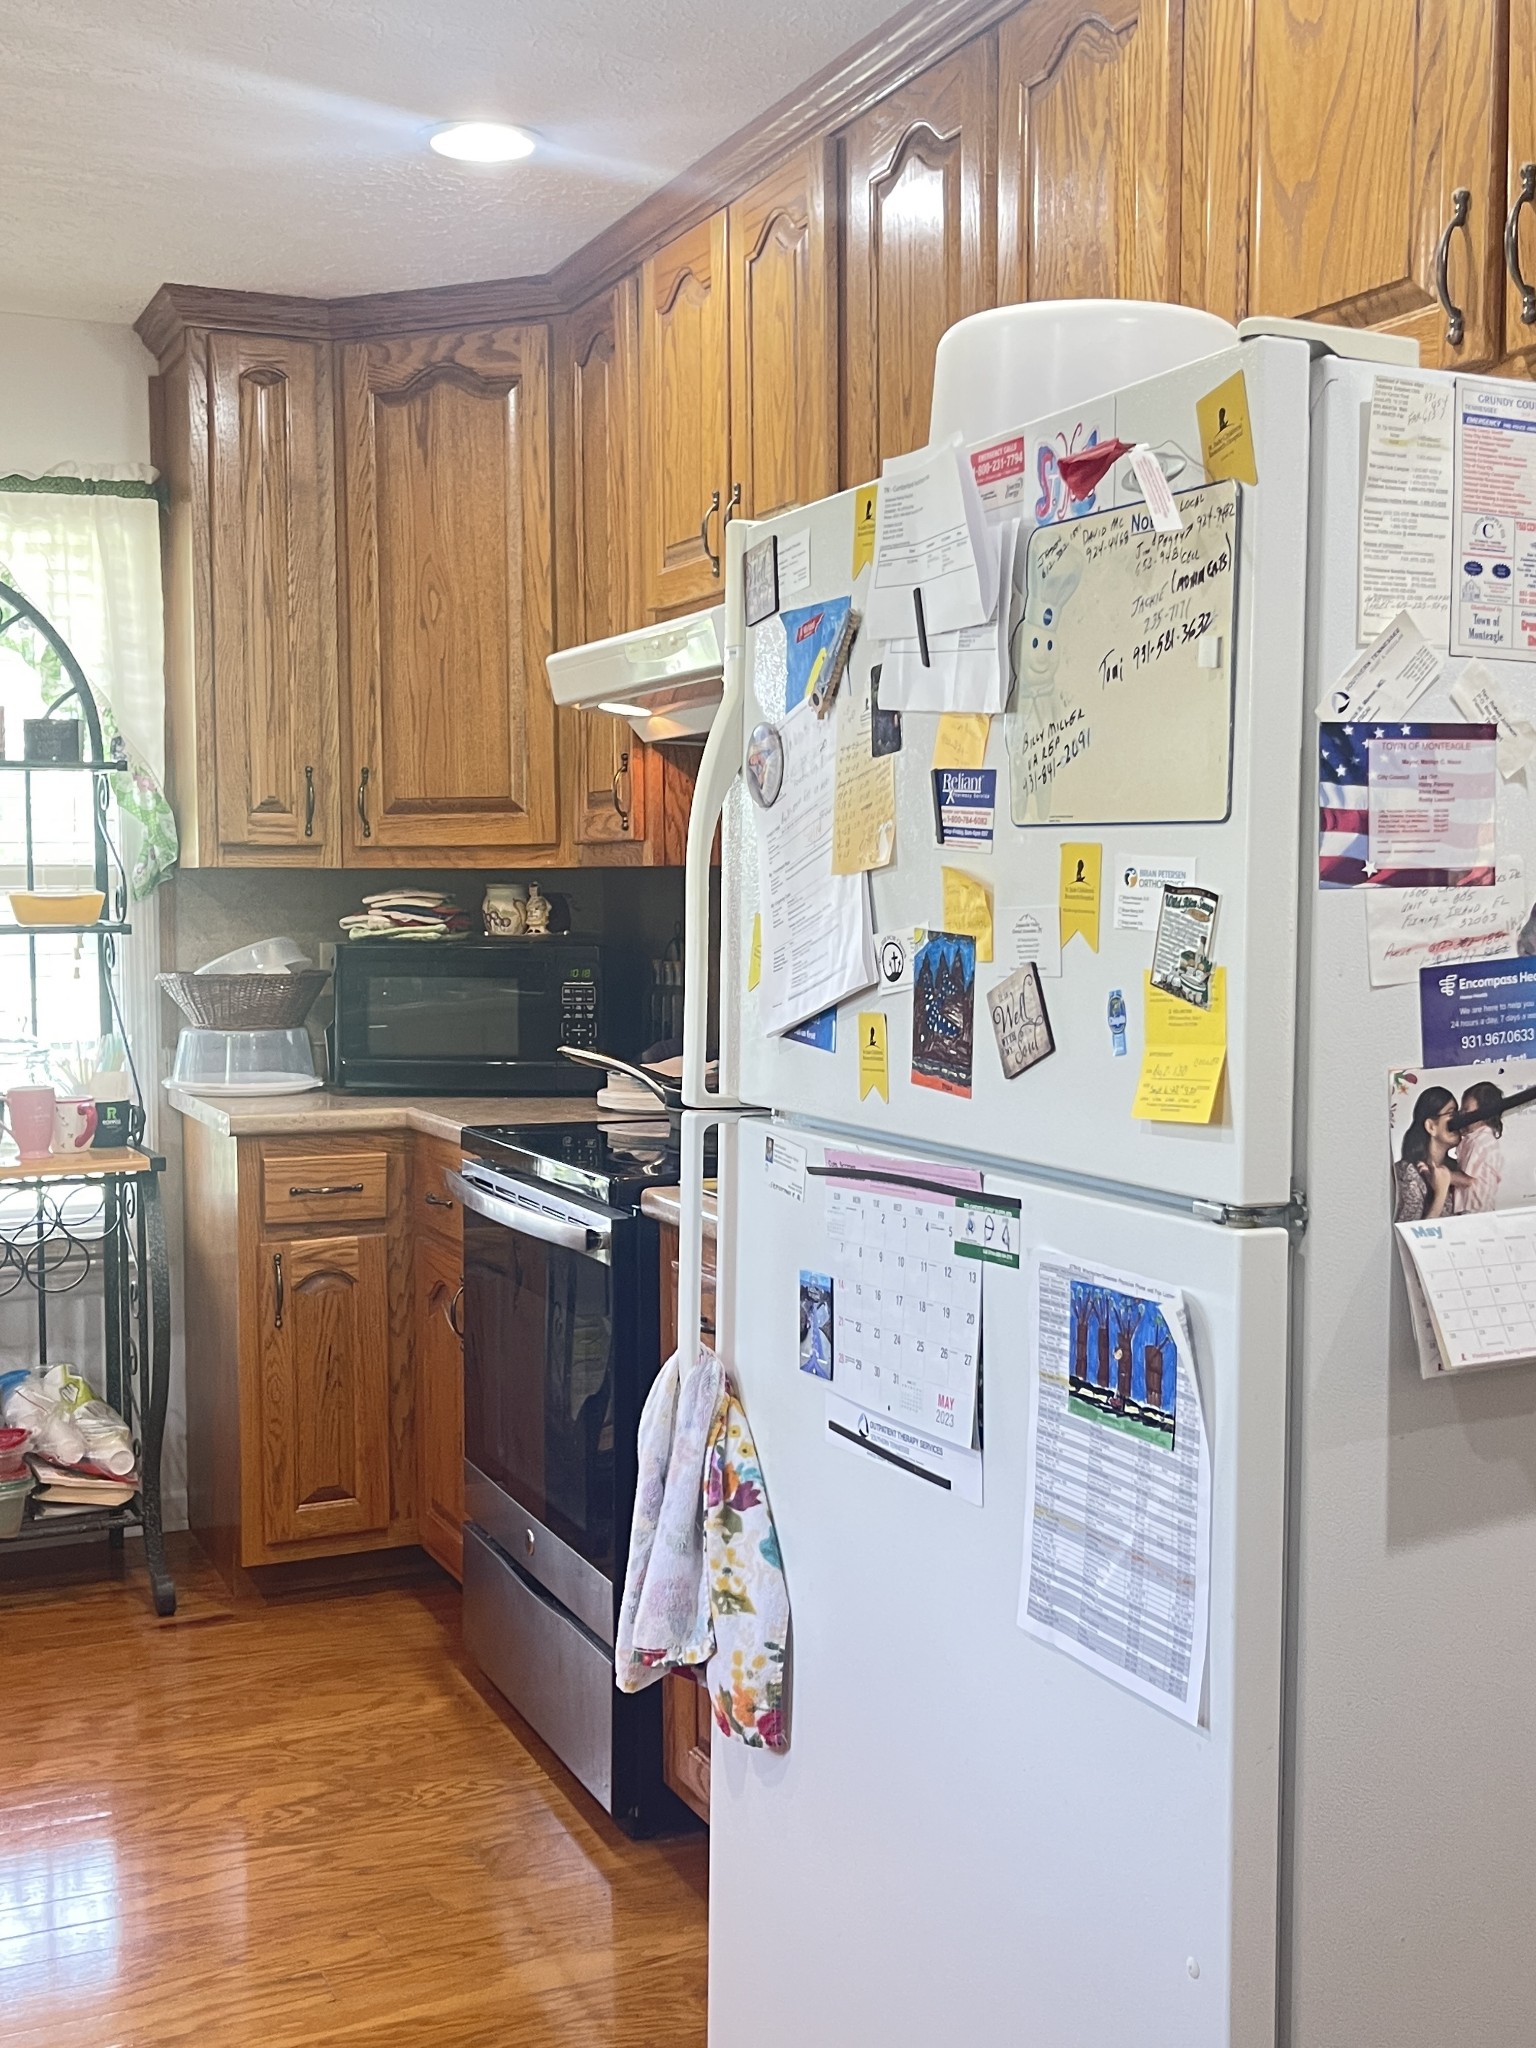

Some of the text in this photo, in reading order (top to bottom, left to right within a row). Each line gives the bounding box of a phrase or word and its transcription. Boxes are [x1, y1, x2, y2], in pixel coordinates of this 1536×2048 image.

[1478, 394, 1536, 410] GRUNDY COU
[1082, 527, 1107, 546] DAVID
[1468, 629, 1504, 644] Monteagle
[1048, 708, 1086, 739] MILLER
[1408, 742, 1420, 751] OF
[1422, 742, 1472, 751] MONTEAGLE
[943, 772, 983, 794] Reliant
[1139, 869, 1186, 879] BRIAN PETERSEN
[1459, 975, 1518, 990] Encompass
[993, 974, 1033, 1034] Well
[1459, 1006, 1471, 1016] We
[1472, 1006, 1483, 1014] are
[1484, 1004, 1499, 1013] here
[1499, 1003, 1507, 1011] to
[1523, 1001, 1535, 1010] you
[1450, 1020, 1460, 1029] 24
[1460, 1018, 1479, 1027] hours
[1500, 1014, 1505, 1023] 7
[1505, 1014, 1521, 1024] days
[1015, 1015, 1044, 1065] Soul
[1461, 1027, 1535, 1050] 931.967.0633
[893, 1203, 902, 1212] WED
[860, 1210, 953, 1237] 1 2 3 4 5
[1411, 1225, 1442, 1239] May
[840, 1243, 976, 1283] 7 8 9 10 11 12 13
[838, 1279, 975, 1325] 14 15 16 17 18 19 20
[838, 1316, 973, 1366] 21 22 23 24 25 26 27
[838, 1352, 900, 1385] 28 29 30 31
[938, 1393, 955, 1410] MAY
[935, 1409, 954, 1428] 2023
[870, 1420, 944, 1456] OUTPATIENT THERAPY SERVICES
